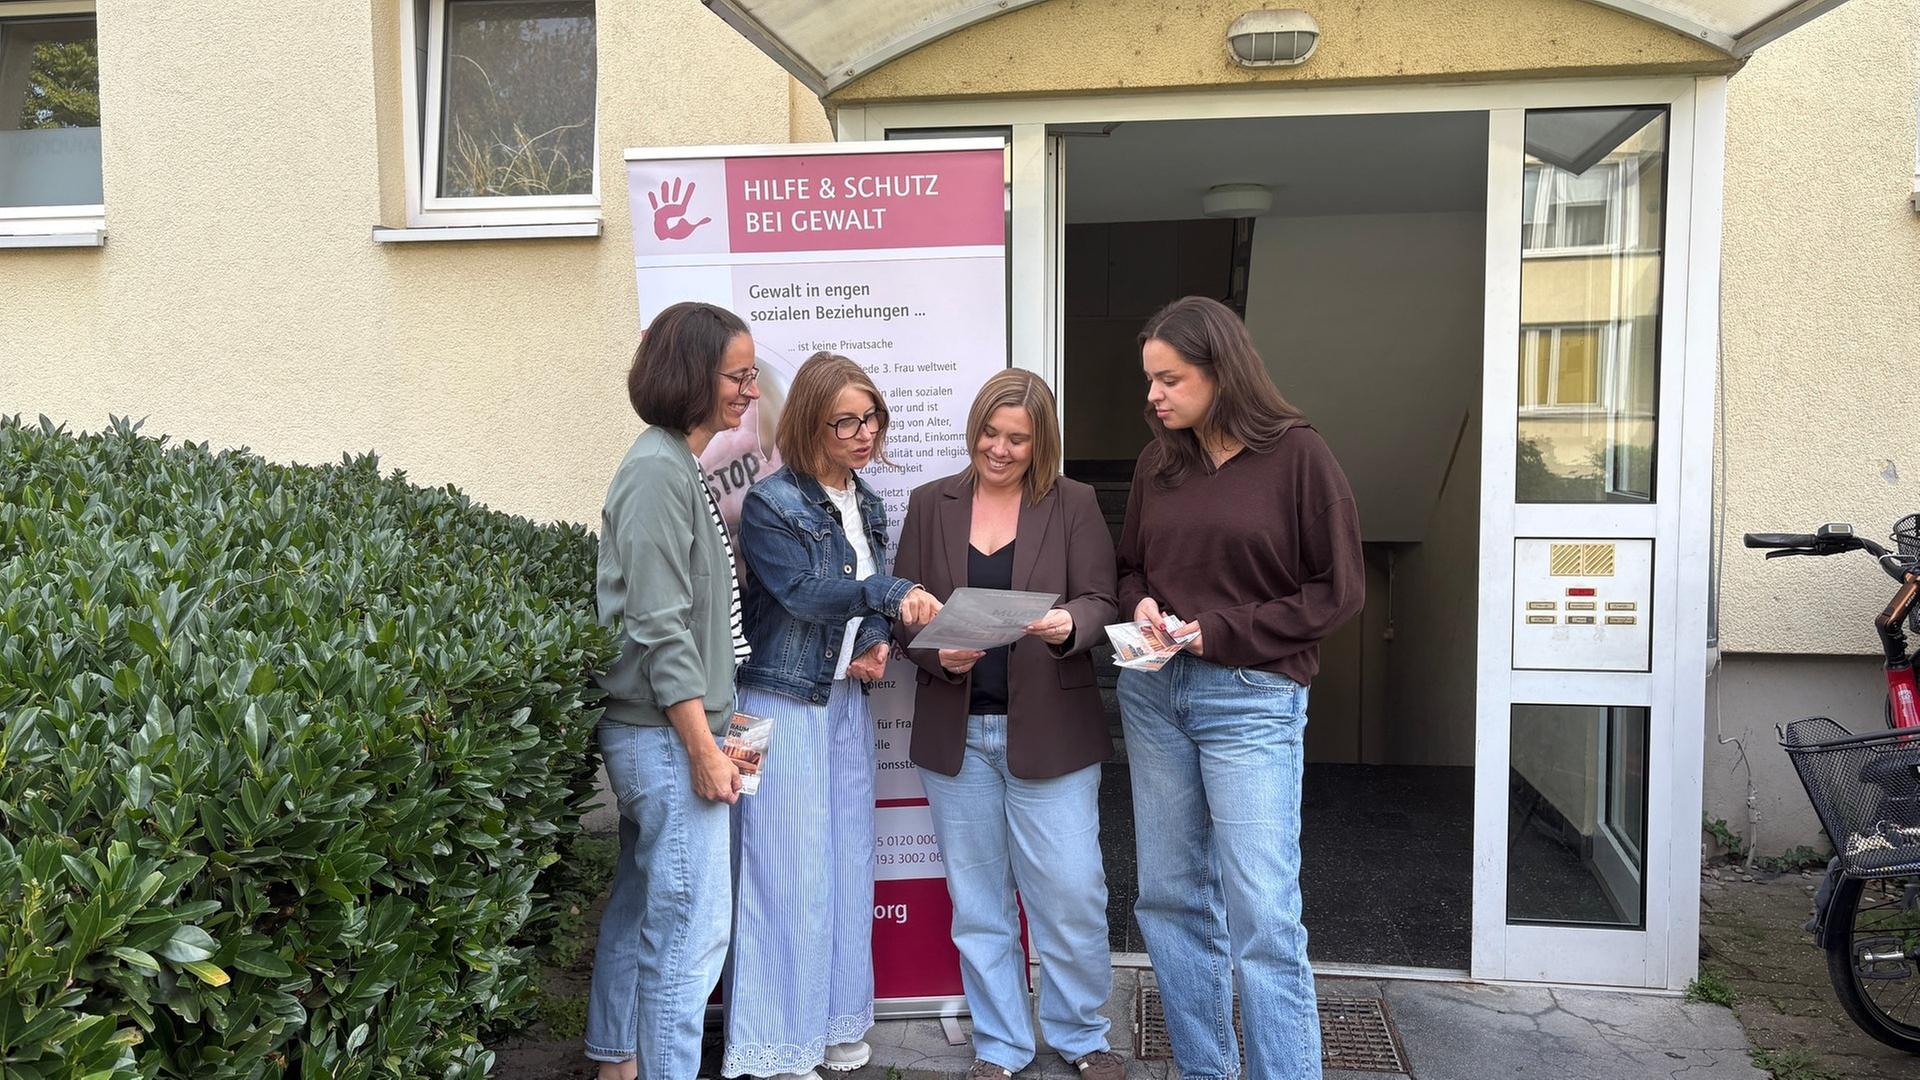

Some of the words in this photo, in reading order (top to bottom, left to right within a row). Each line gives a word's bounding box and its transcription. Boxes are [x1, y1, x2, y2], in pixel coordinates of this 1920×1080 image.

[744, 178, 810, 200] HILFE
[819, 177, 836, 199] &
[844, 174, 939, 198] SCHUTZ
[746, 211, 782, 233] BEI
[791, 208, 887, 232] GEWALT
[749, 283, 801, 299] Gewalt
[806, 283, 820, 297] in
[825, 284, 870, 300] engen
[750, 306, 810, 321] sozialen
[816, 304, 909, 321] Beziehungen
[798, 341, 809, 352] ist
[812, 341, 837, 351] keine
[840, 339, 893, 350] Privatsache
[862, 364, 880, 374] ede
[883, 363, 892, 374] 3.
[894, 363, 915, 373] Frau
[917, 361, 957, 371] weltweit
[889, 387, 913, 398] allen
[915, 386, 953, 397] sozialen
[889, 405, 903, 413] vor
[906, 402, 924, 412] und
[927, 402, 938, 411] ist
[889, 418, 905, 431] gig
[907, 419, 924, 428] von
[926, 416, 952, 427] Alter,
[916, 447, 934, 457] und
[875, 739, 891, 750] lle
[877, 836, 884, 847] 5
[887, 835, 914, 847] 0120
[898, 852, 926, 864] 3002
